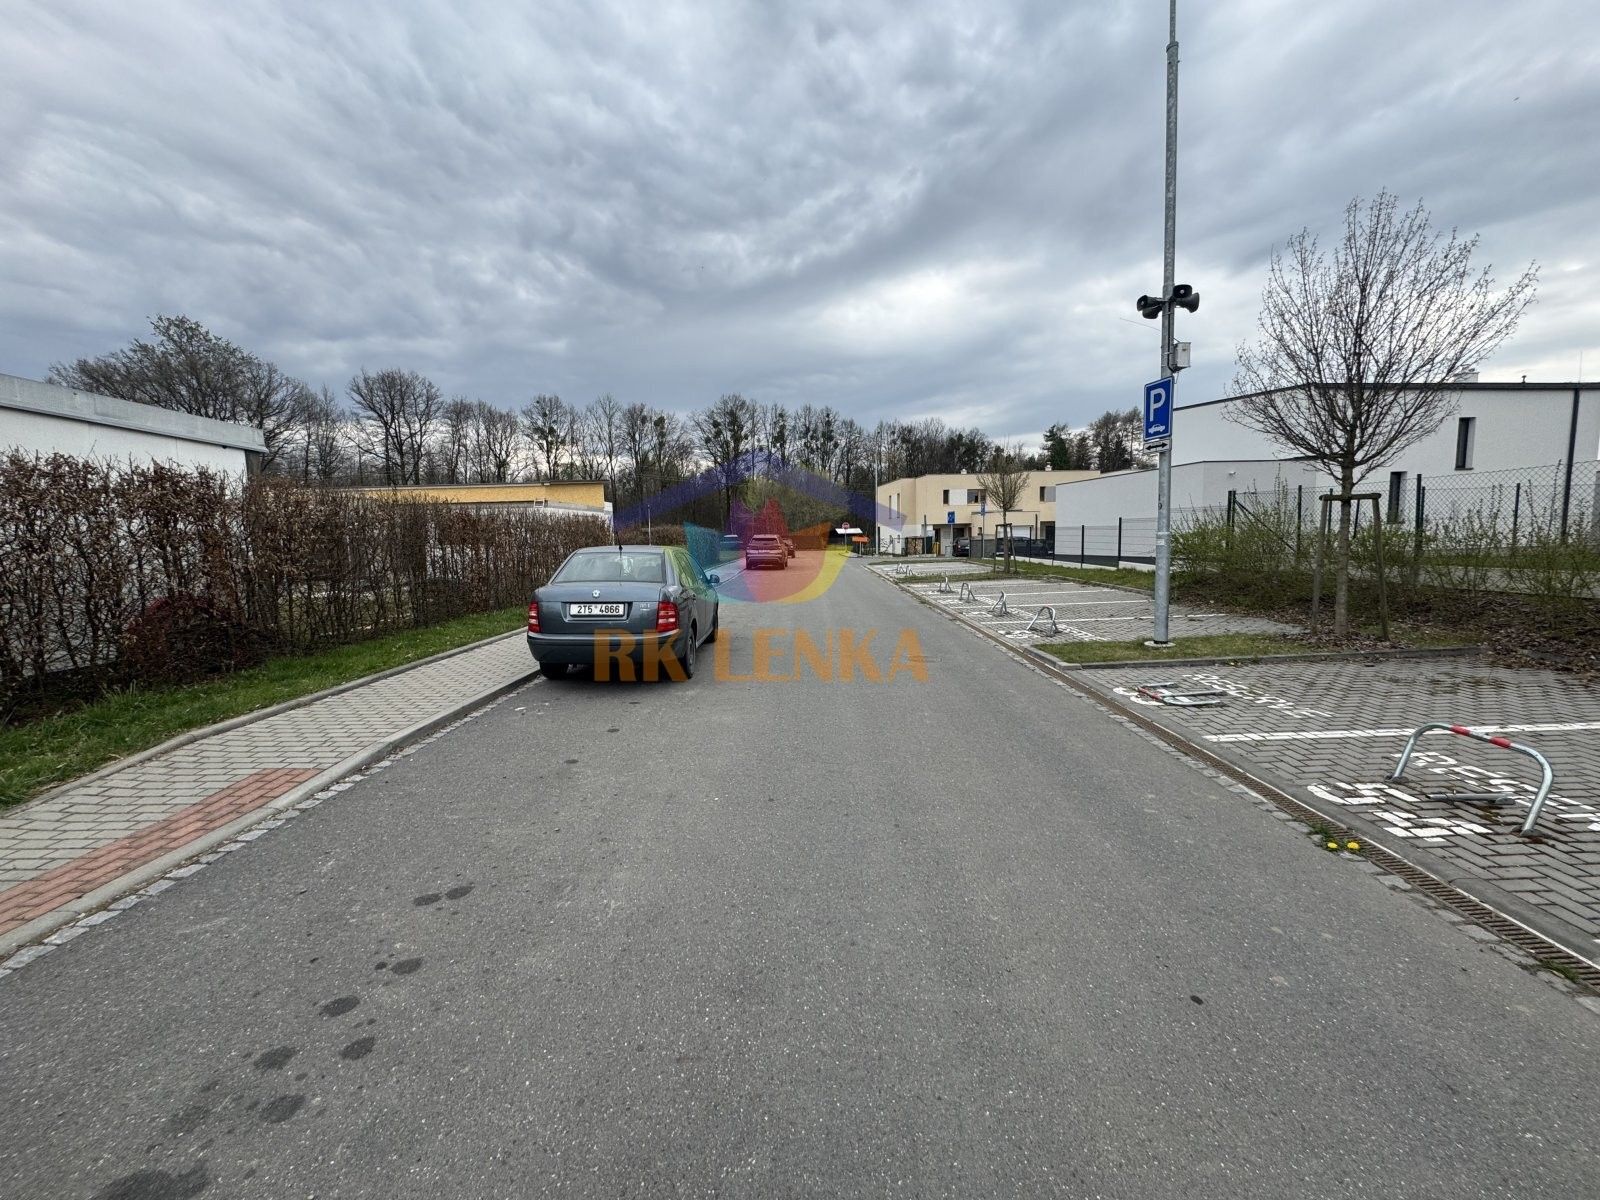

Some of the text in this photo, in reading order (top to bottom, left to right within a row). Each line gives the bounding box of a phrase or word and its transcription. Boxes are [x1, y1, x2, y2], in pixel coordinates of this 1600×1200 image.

[1150, 387, 1166, 422] P
[577, 605, 620, 614] 2T5 4866
